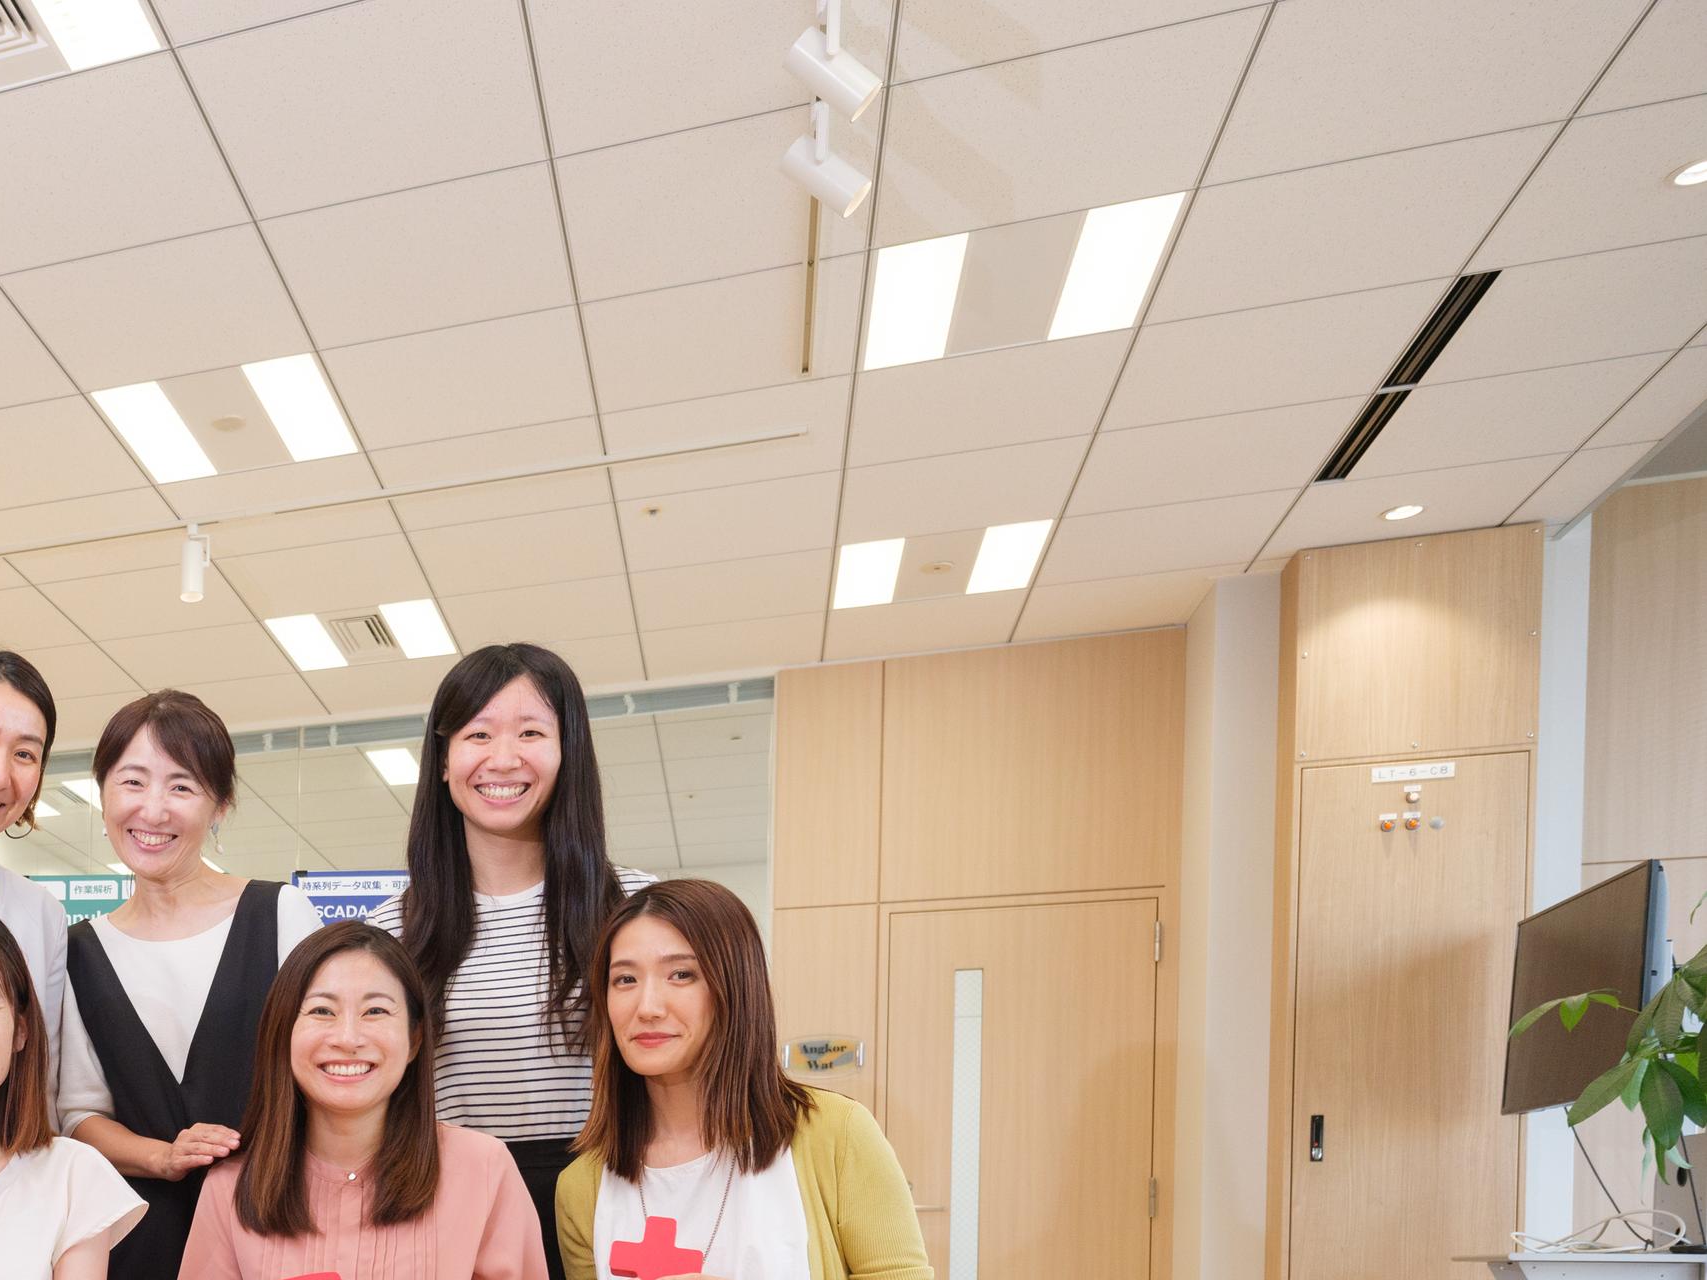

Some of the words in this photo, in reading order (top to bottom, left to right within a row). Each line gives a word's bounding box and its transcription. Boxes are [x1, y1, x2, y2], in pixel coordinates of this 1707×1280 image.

[74, 884, 113, 895] 作業解析
[802, 1043, 847, 1054] Angkor
[807, 1060, 834, 1069] Wat
